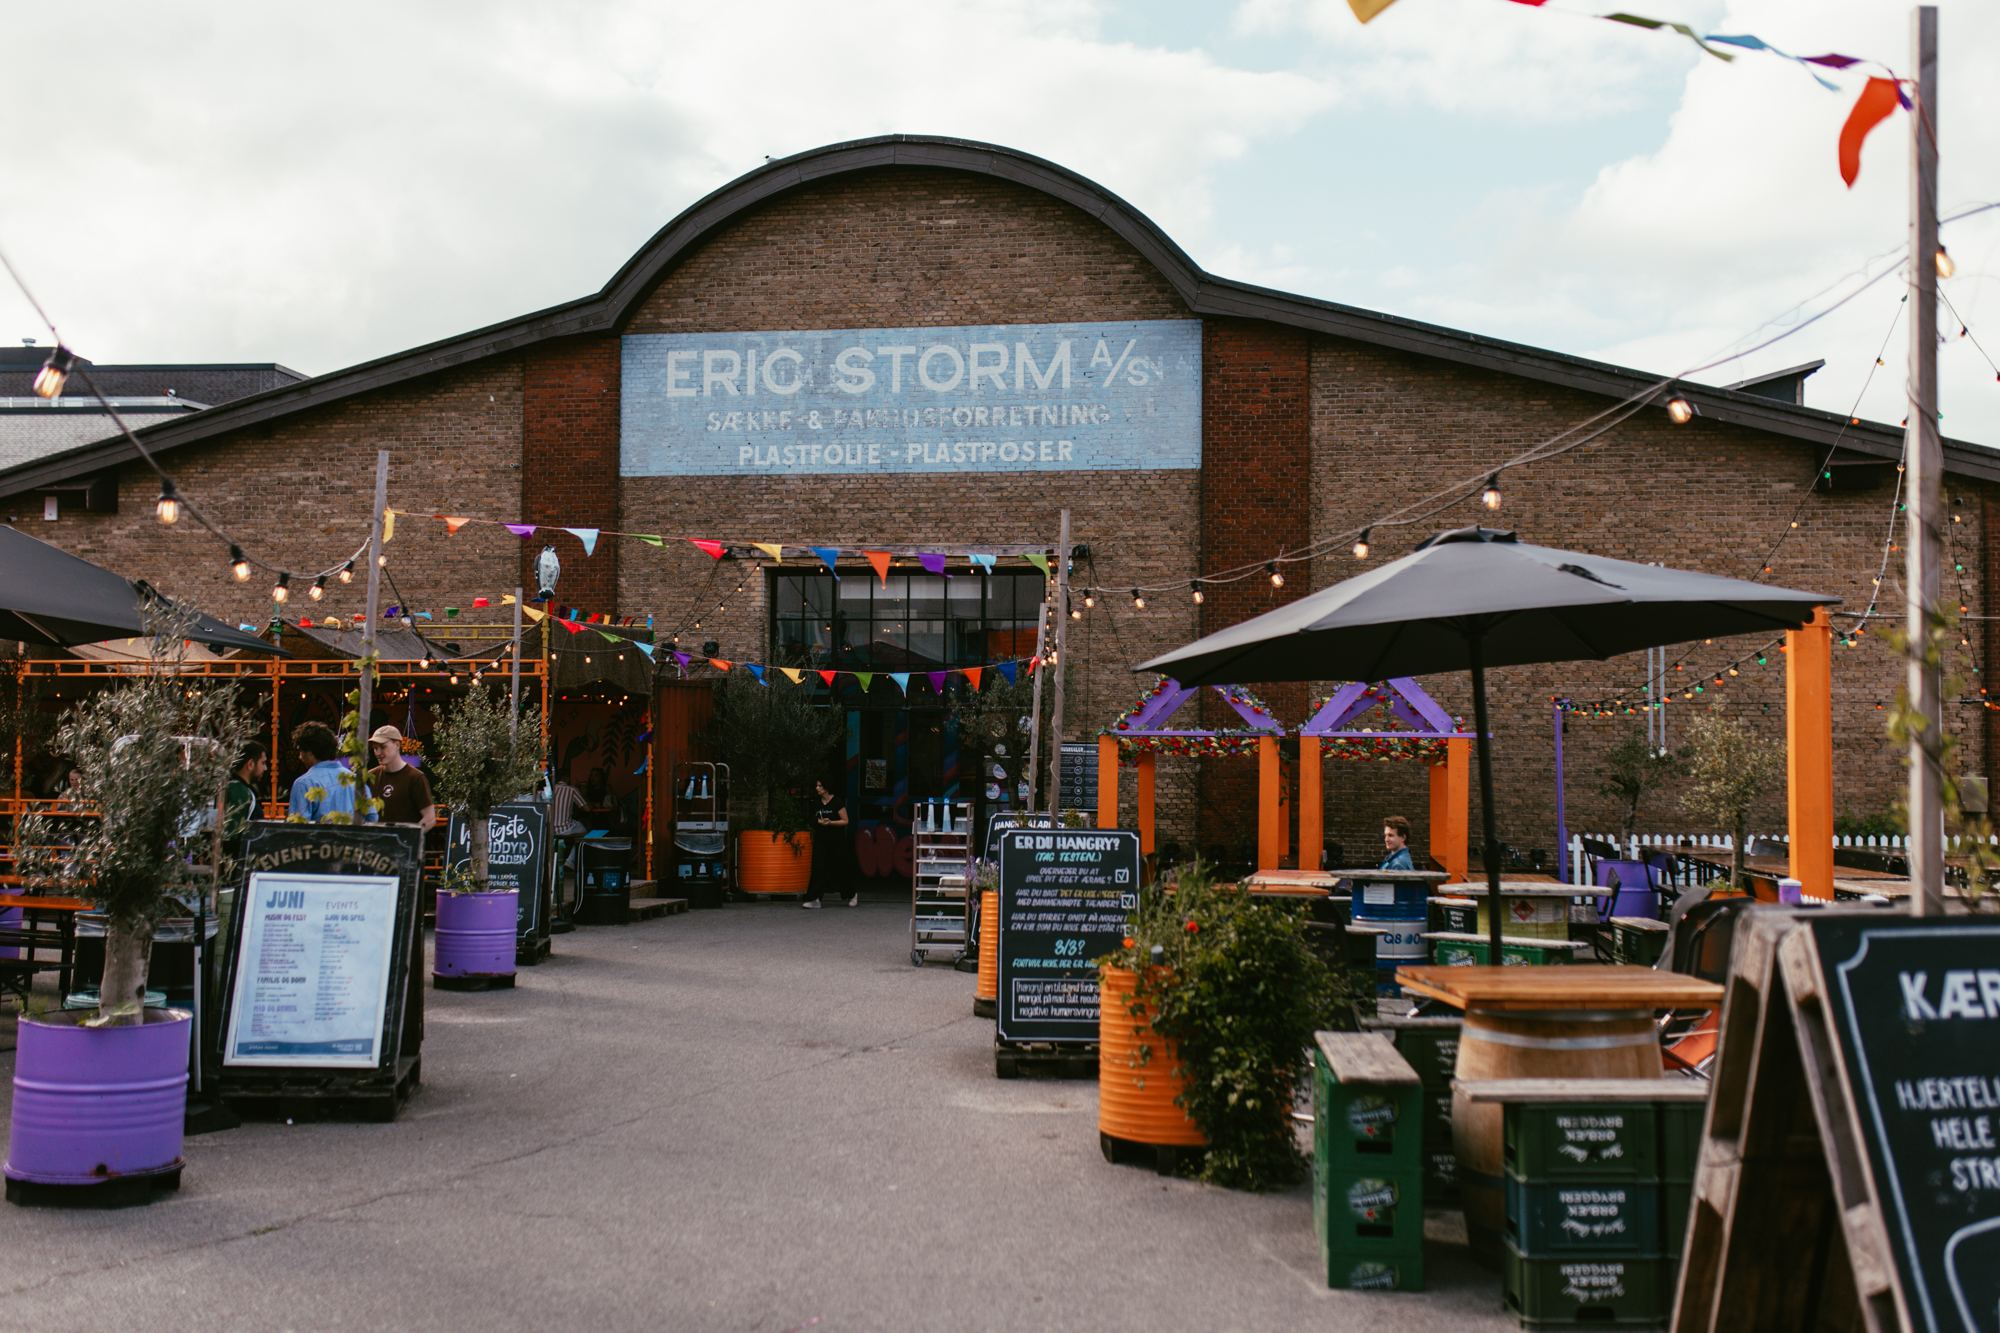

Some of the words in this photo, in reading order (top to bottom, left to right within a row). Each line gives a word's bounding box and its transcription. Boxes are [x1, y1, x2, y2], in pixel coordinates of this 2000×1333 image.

[666, 348, 804, 398] ERIC
[835, 340, 1071, 394] STORM
[808, 410, 823, 430] &
[739, 443, 881, 466] PLASTFOLIE
[908, 440, 1073, 464] PLASTPOSER
[460, 814, 528, 846] htigste
[1015, 835, 1034, 850] ER
[1036, 836, 1053, 850] DU
[1056, 836, 1121, 851] HANGRY?
[258, 844, 399, 876] EVENT-OVERSIGT
[1035, 852, 1055, 863] (TAG
[1078, 867, 1089, 876] DU
[1090, 867, 1100, 876] AT
[1044, 875, 1056, 884] DIT
[1058, 875, 1080, 884] EGET
[266, 890, 305, 910] JUNI
[1015, 889, 1030, 898] HAR
[1031, 889, 1041, 898] DU
[326, 901, 359, 911] EVENTS
[292, 914, 307, 922] FEST
[1088, 912, 1099, 924] PÅ
[1383, 933, 1402, 945] Q8
[1054, 939, 1086, 956] 3/3?
[1072, 958, 1084, 968] ER
[1556, 1115, 1624, 1129] BRYGGERI
[1565, 1129, 1617, 1142] ØRBÆK
[1931, 1115, 1996, 1149] HELE
[1558, 1190, 1626, 1204] BRYGGERI
[1567, 1203, 1619, 1217] ØRBÆK
[1560, 1263, 1625, 1276] BRYGGERI
[1569, 1275, 1618, 1287] ØRBÆK
